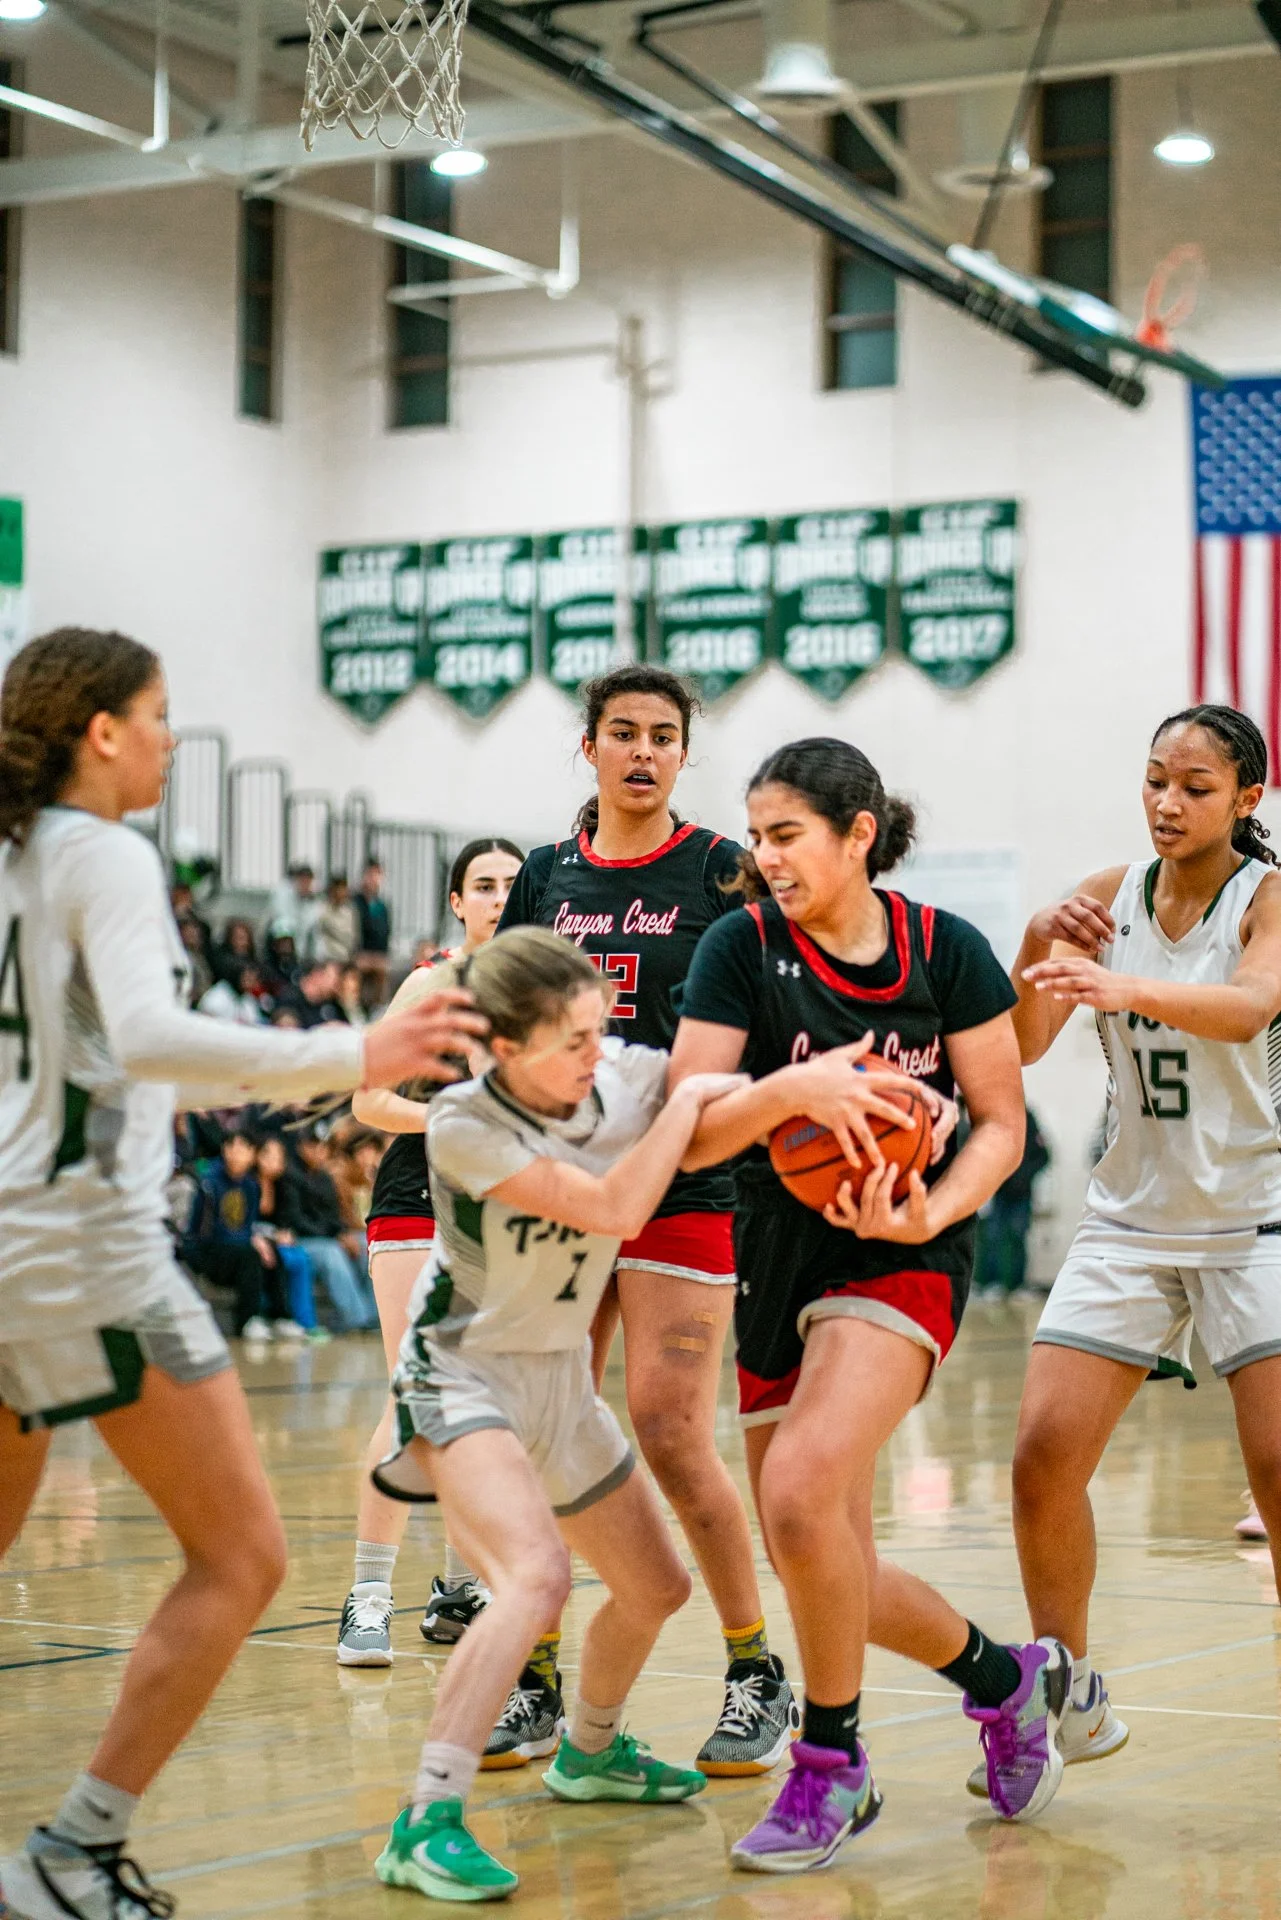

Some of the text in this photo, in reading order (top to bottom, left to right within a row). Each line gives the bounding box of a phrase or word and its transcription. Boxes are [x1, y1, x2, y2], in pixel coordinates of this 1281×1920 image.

[553, 635, 615, 683] 201
[665, 626, 762, 673] 2016
[784, 620, 882, 670] 2016
[909, 613, 1007, 664] 2017
[435, 641, 527, 688] 2014
[553, 898, 680, 947] Canyon Crest
[883, 1030, 941, 1077] Crest
[1131, 1048, 1190, 1121] 15
